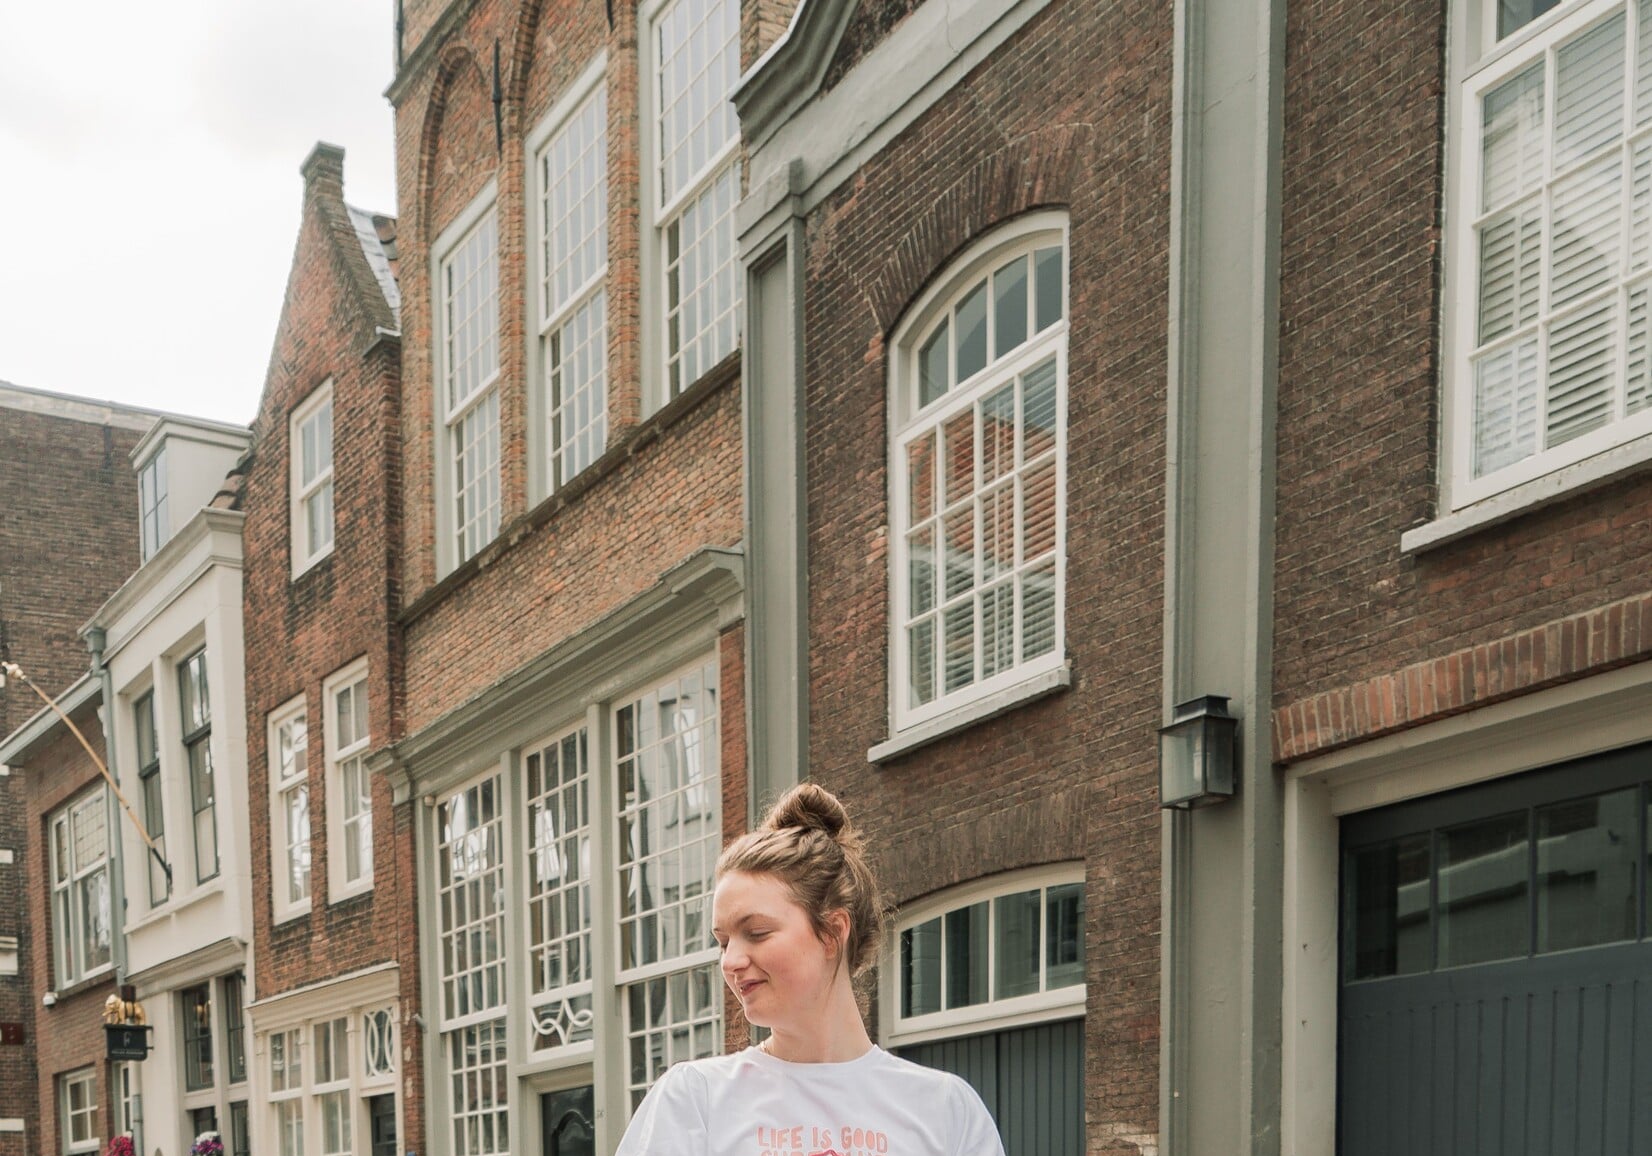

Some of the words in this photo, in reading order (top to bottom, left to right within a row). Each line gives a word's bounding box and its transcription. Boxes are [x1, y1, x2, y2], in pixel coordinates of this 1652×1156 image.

[757, 1126, 803, 1149] LIFE
[812, 1126, 832, 1149] IS
[840, 1126, 888, 1153] GOOD
